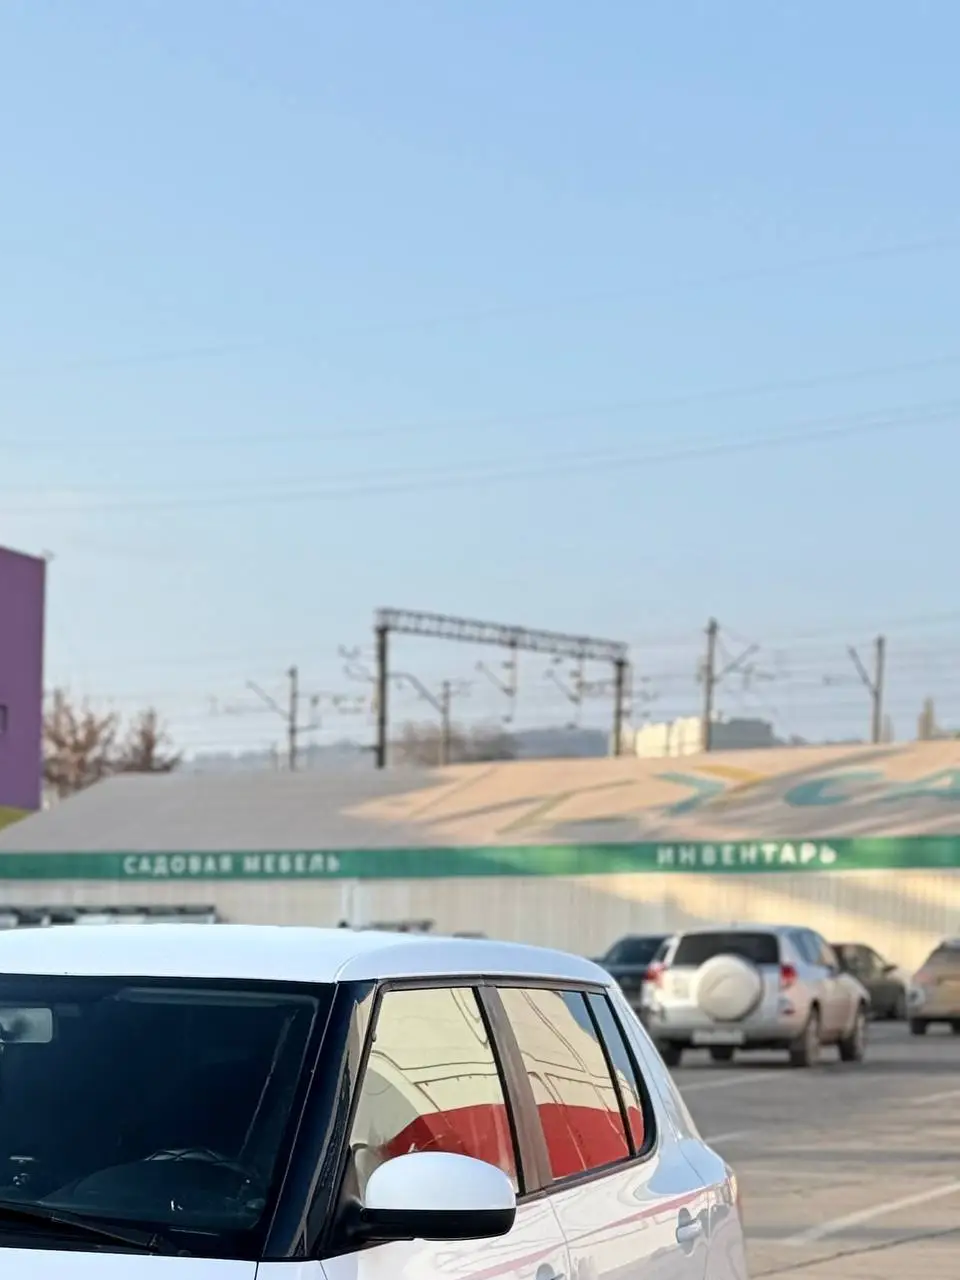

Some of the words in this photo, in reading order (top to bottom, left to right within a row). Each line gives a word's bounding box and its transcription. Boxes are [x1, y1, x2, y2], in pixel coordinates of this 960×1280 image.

[122, 854, 233, 876] САДОВАЯ
[243, 852, 340, 874] МЕБЕЛЬ
[656, 841, 837, 866] ИНВЕНТАРЬ
